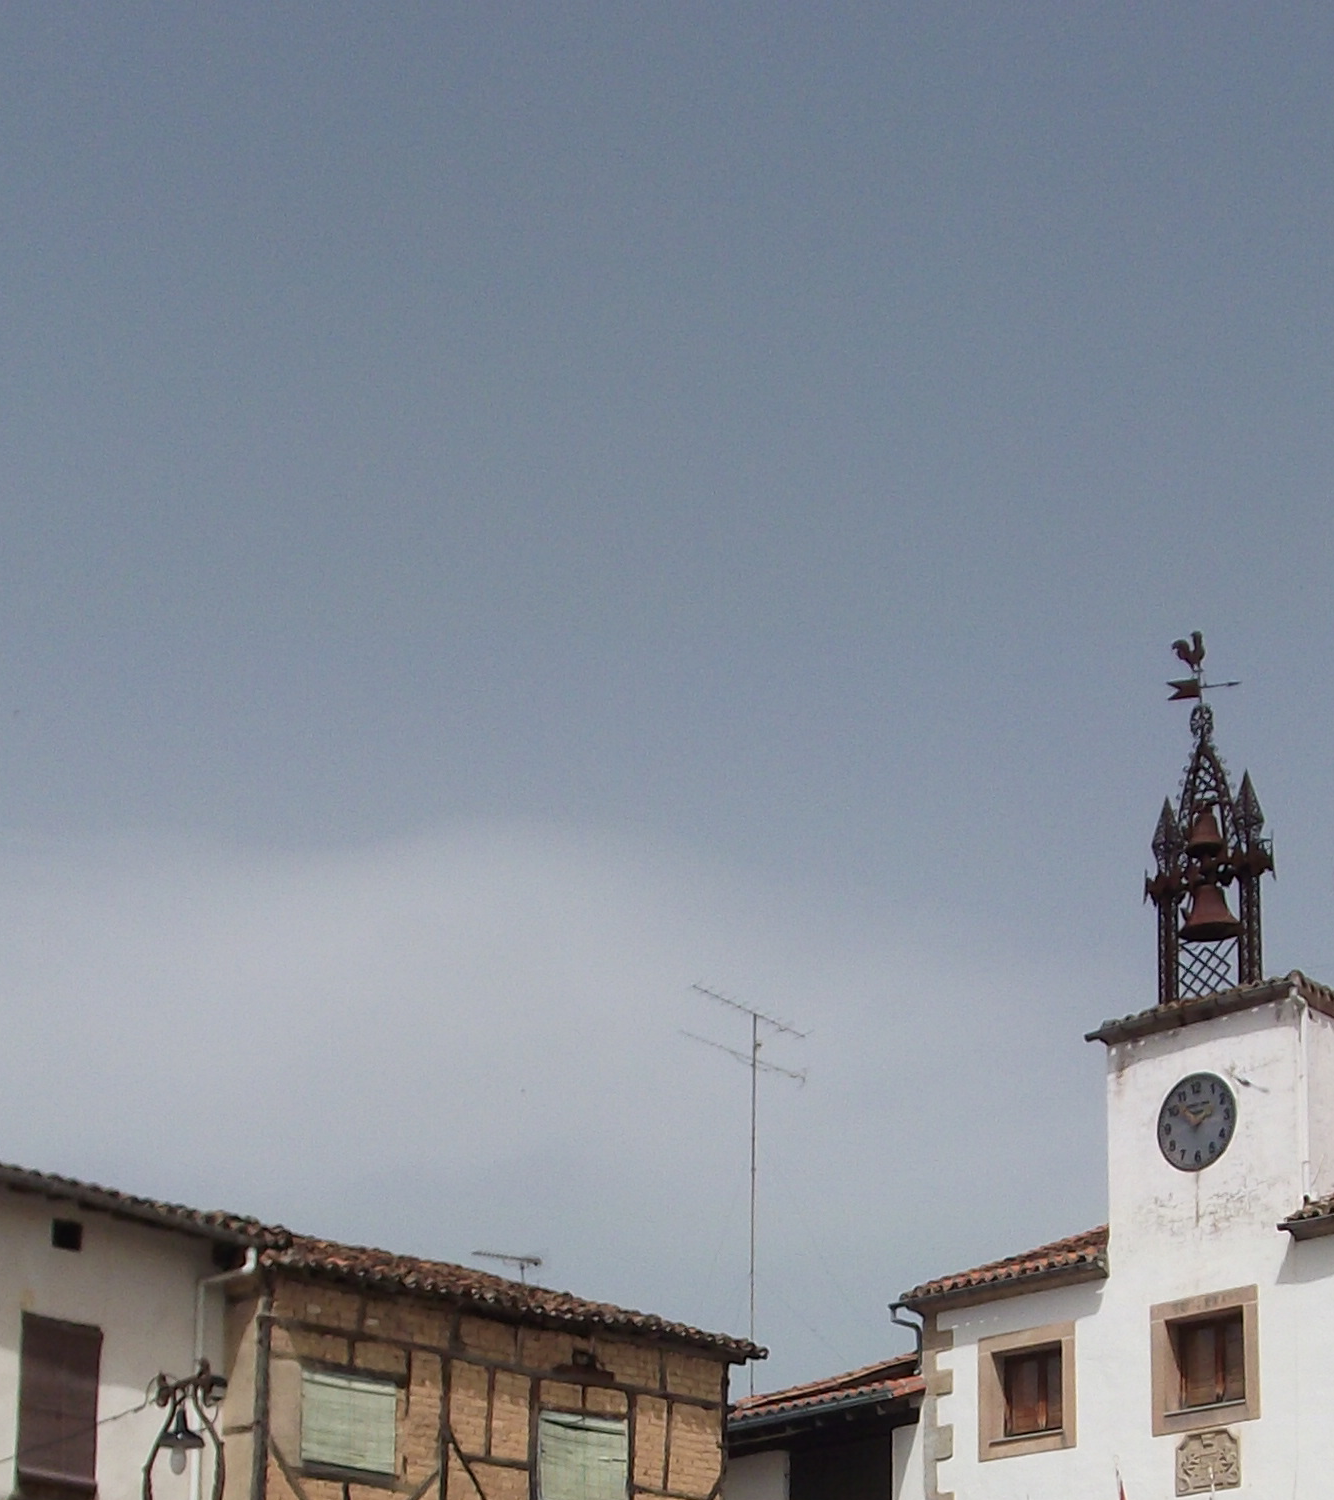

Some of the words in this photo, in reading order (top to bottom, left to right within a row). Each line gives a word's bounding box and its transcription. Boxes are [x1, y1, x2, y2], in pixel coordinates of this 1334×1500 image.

[1190, 1081, 1202, 1095] 12
[1210, 1082, 1215, 1095] 1
[1177, 1091, 1187, 1102] 11
[1219, 1092, 1226, 1105] 2
[1168, 1104, 1180, 1117] 10
[1223, 1107, 1231, 1120] 3
[1163, 1123, 1172, 1136] 9
[1218, 1126, 1226, 1139] 4
[1169, 1139, 1177, 1152] 8
[1208, 1141, 1216, 1154] 5
[1180, 1149, 1187, 1161] 7
[1194, 1149, 1202, 1162] 6
